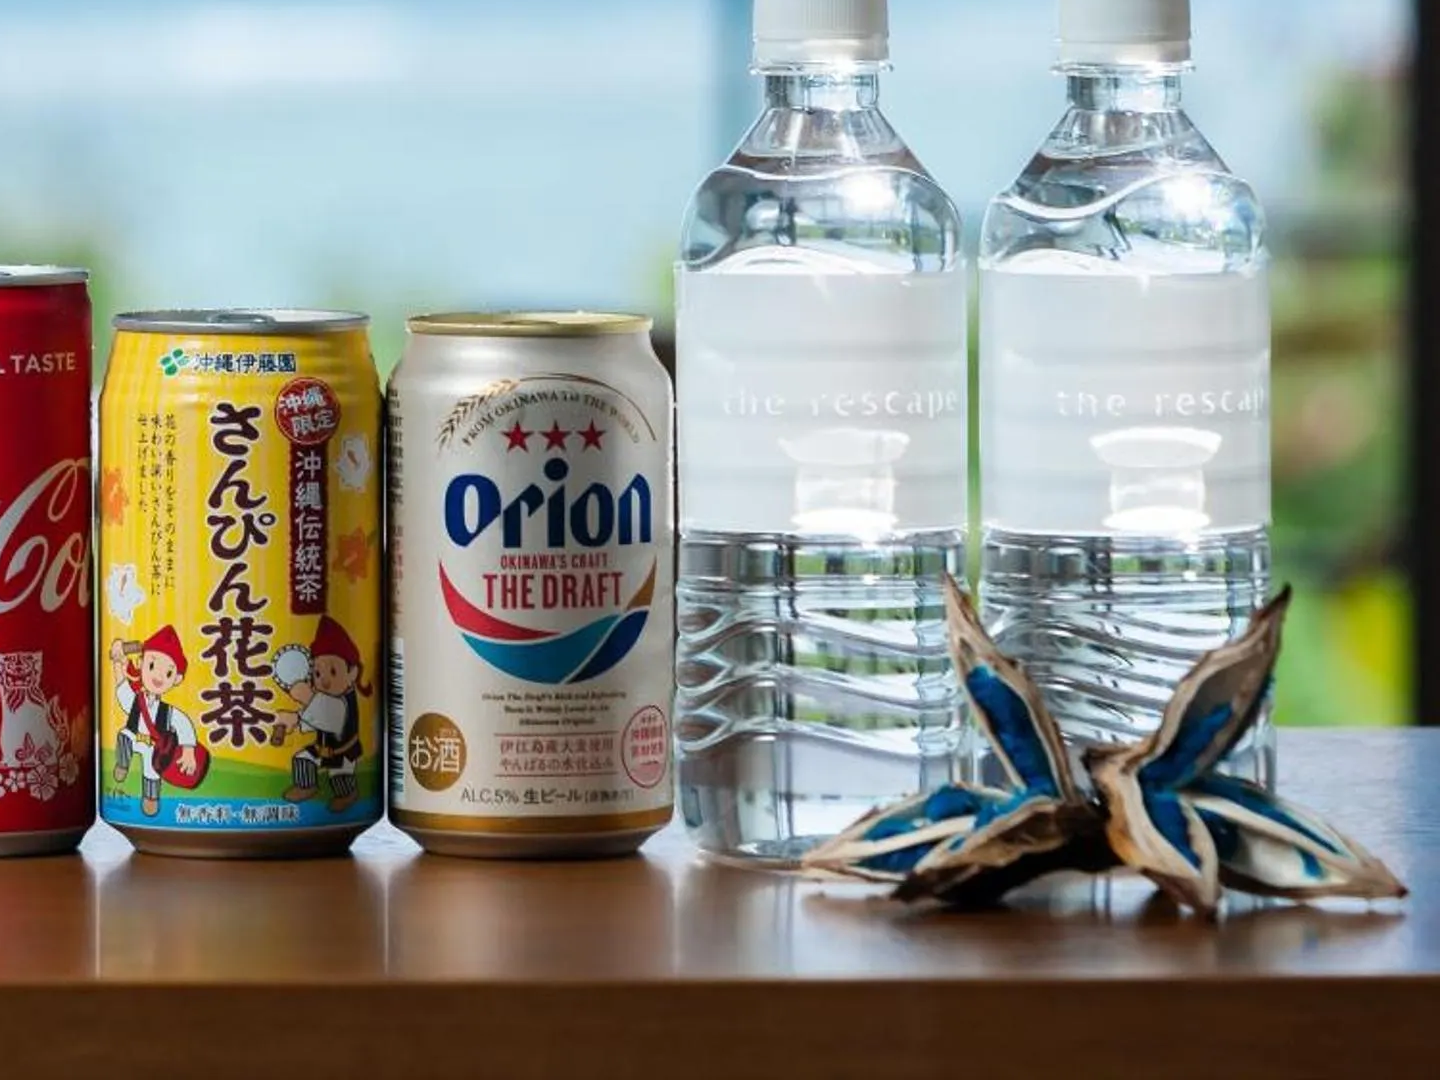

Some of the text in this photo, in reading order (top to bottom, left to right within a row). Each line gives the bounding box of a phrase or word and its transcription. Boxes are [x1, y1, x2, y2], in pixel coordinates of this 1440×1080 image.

[11, 352, 76, 373] TASTE
[494, 390, 558, 418] OKINAWA
[583, 394, 606, 411] THE
[724, 385, 959, 418] the rescape
[1056, 390, 1127, 417] the
[295, 451, 323, 602] 沖縄伝統茶
[201, 402, 276, 747] さんぴん花茶
[500, 553, 608, 569] OKINAWA'S CRAFT
[483, 572, 624, 609] THE DRAFT
[411, 735, 461, 774] お酒
